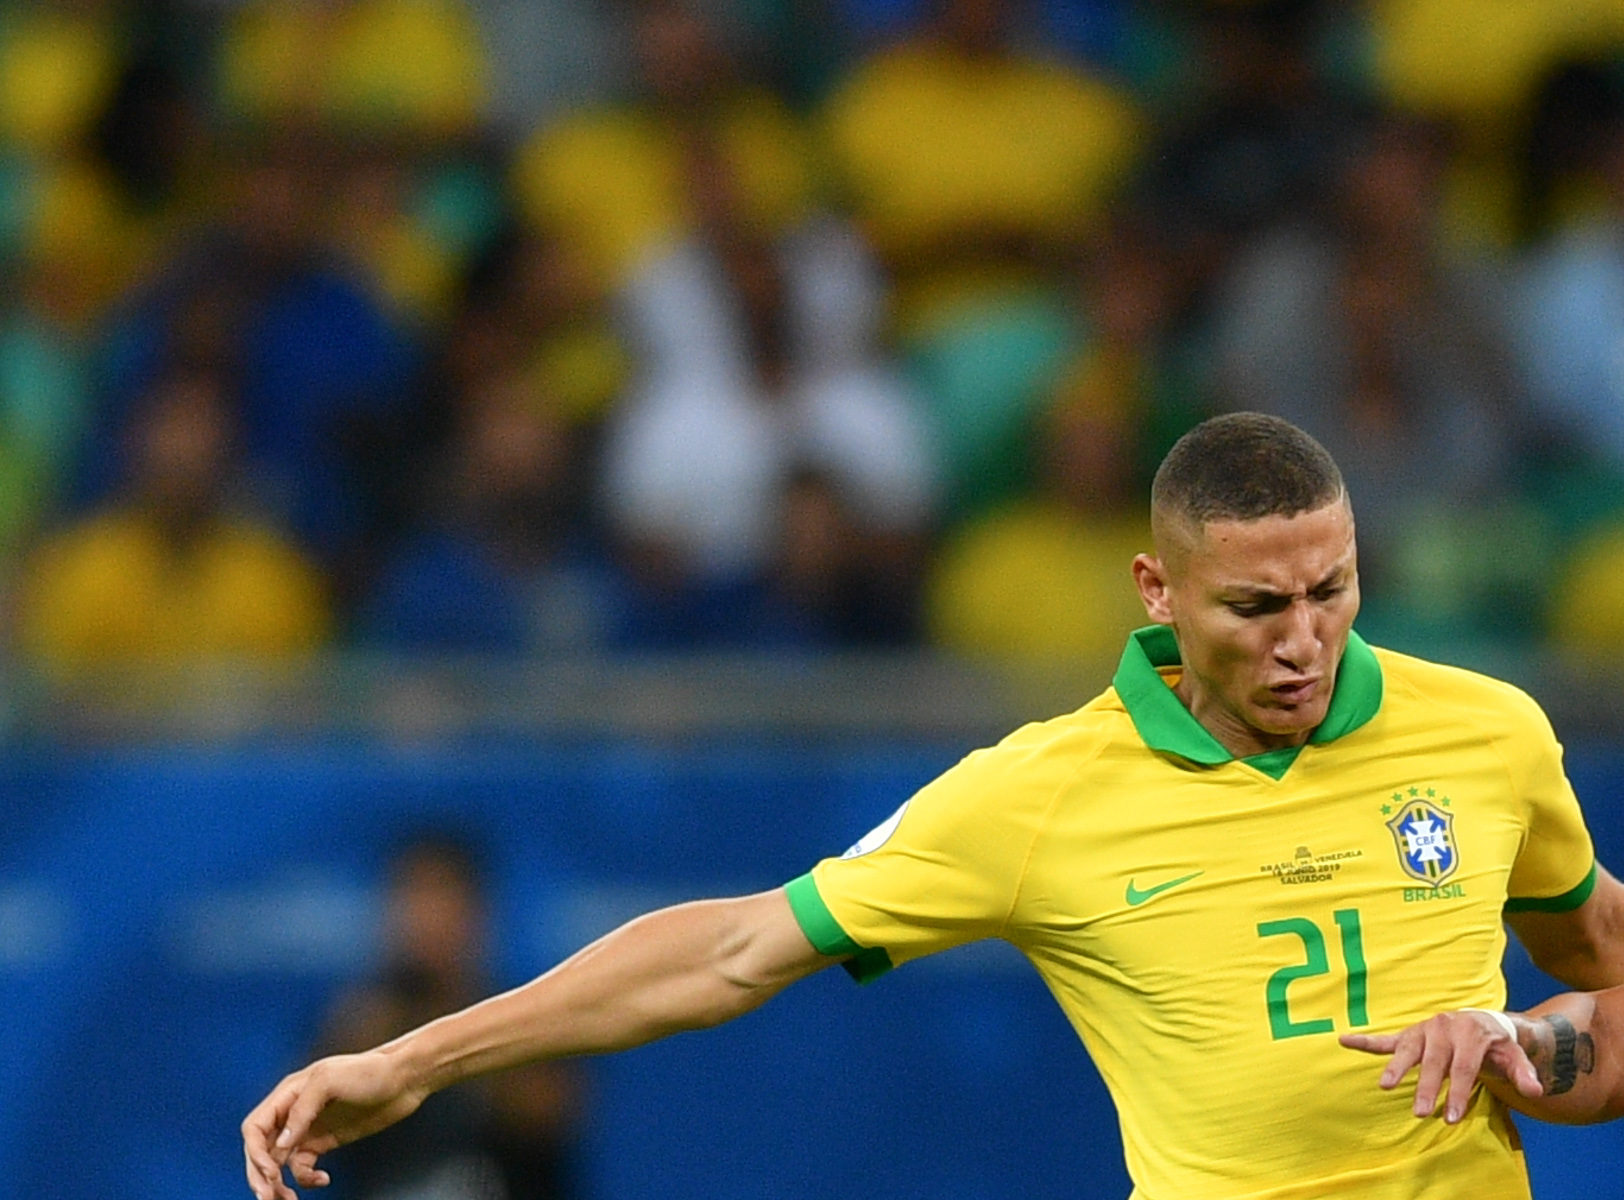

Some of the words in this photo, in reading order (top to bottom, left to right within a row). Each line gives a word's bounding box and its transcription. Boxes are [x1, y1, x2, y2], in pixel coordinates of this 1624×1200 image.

[1415, 834, 1437, 847] CBF
[1260, 861, 1295, 872] BRASIL
[1314, 850, 1363, 863] VENEZUELA
[1318, 863, 1341, 873] 2019
[1280, 873, 1333, 884] SALVADOR
[1403, 884, 1466, 902] BRASIL
[1257, 908, 1369, 1041] 21
